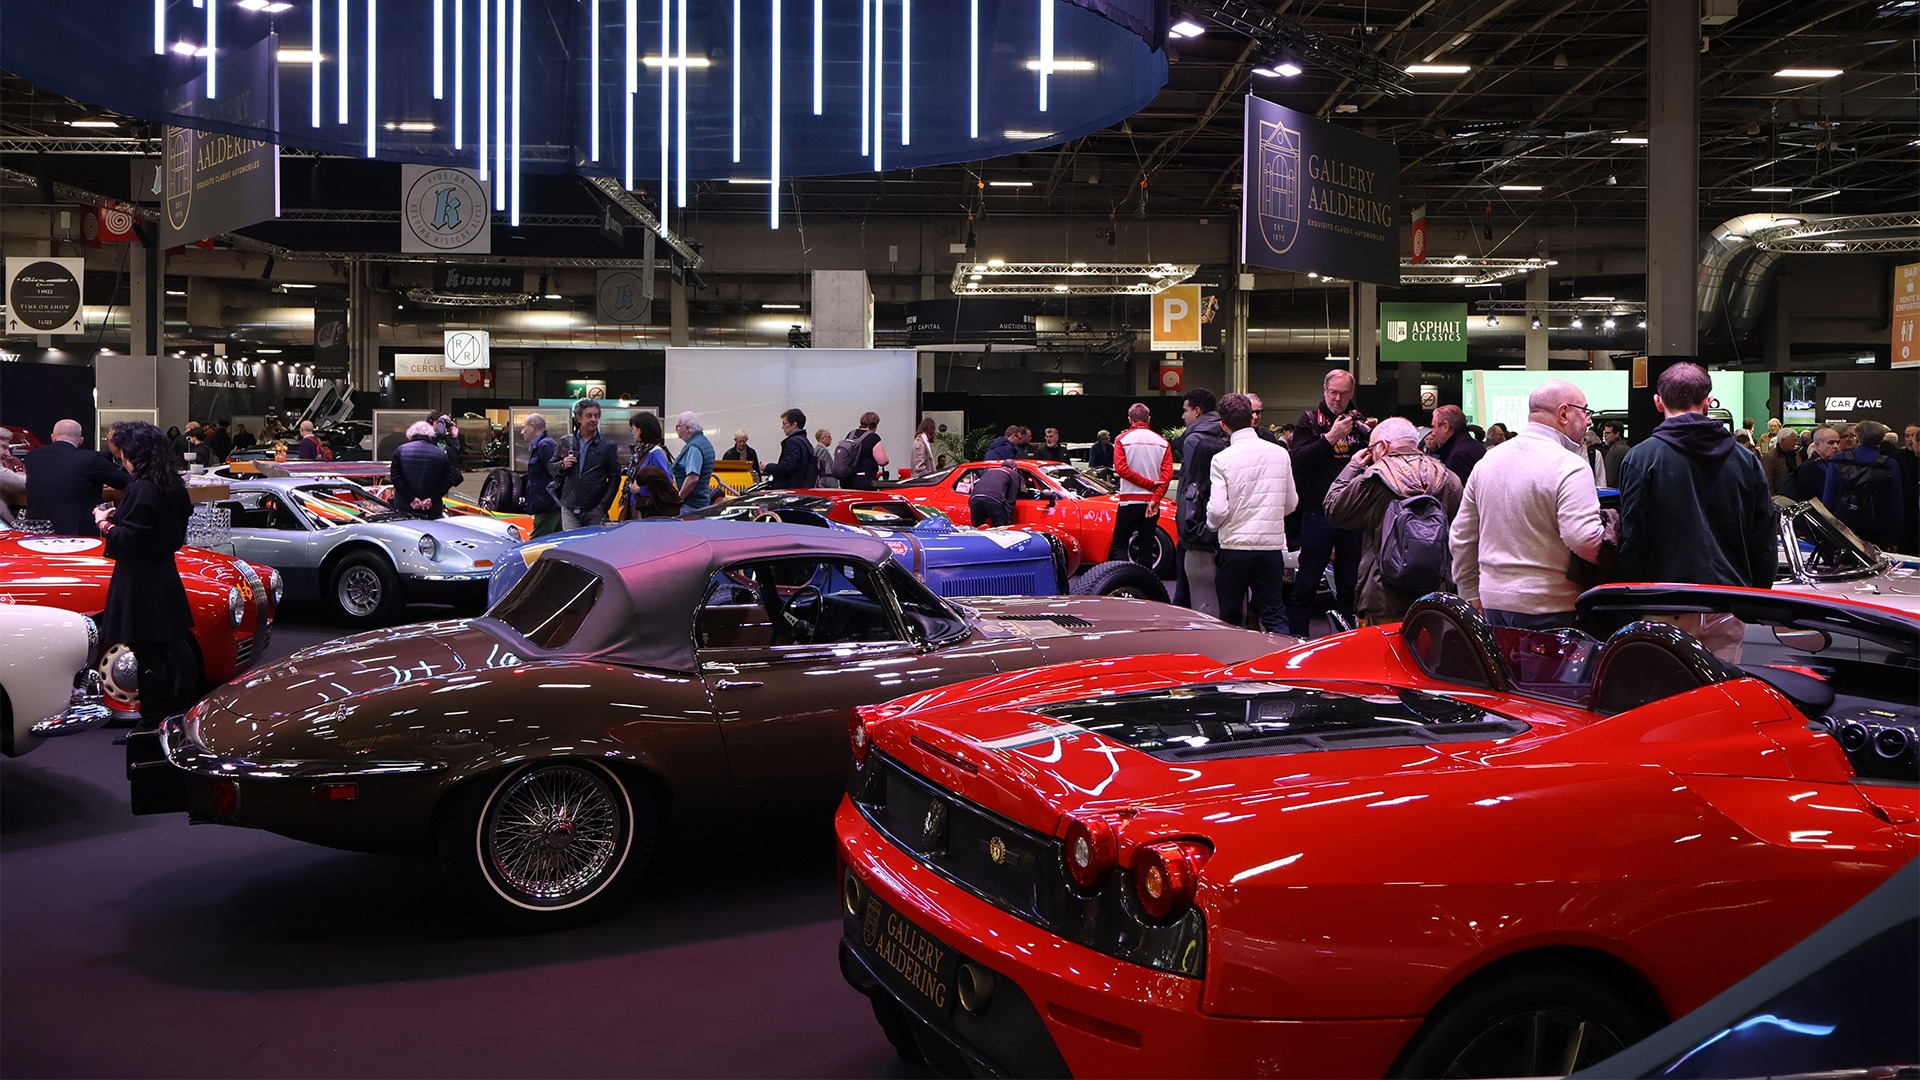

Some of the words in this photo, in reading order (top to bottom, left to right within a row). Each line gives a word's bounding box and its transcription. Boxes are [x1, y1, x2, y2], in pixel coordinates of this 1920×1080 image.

[427, 172, 466, 185] KIDSTON
[1308, 154, 1376, 194] GALLERY
[1308, 186, 1392, 228] AALDERING
[410, 203, 431, 239] KEEPING
[433, 230, 471, 245] HISTORY
[1273, 223, 1284, 231] EST
[1307, 218, 1334, 231] EXQUISITE
[1334, 224, 1354, 235] CLASSIC
[1354, 230, 1385, 242] AUTOMOBILES
[1272, 233, 1286, 243] 1975
[1453, 230, 1468, 241] 37
[1904, 267, 1918, 278] BAR
[1163, 298, 1189, 333] P
[999, 323, 1027, 331] AUCTIONS
[1412, 320, 1461, 334] ASPHALT
[1412, 332, 1461, 342] CLASSICS
[455, 339, 463, 348] R
[463, 352, 471, 361] R
[214, 360, 229, 375] ON
[231, 362, 259, 377] SHOW
[410, 364, 445, 373] CERCLE
[1831, 400, 1851, 408] CAR
[1856, 399, 1882, 409] CAVE
[887, 913, 944, 974] GALLERY
[875, 933, 946, 1008] AALDERING
